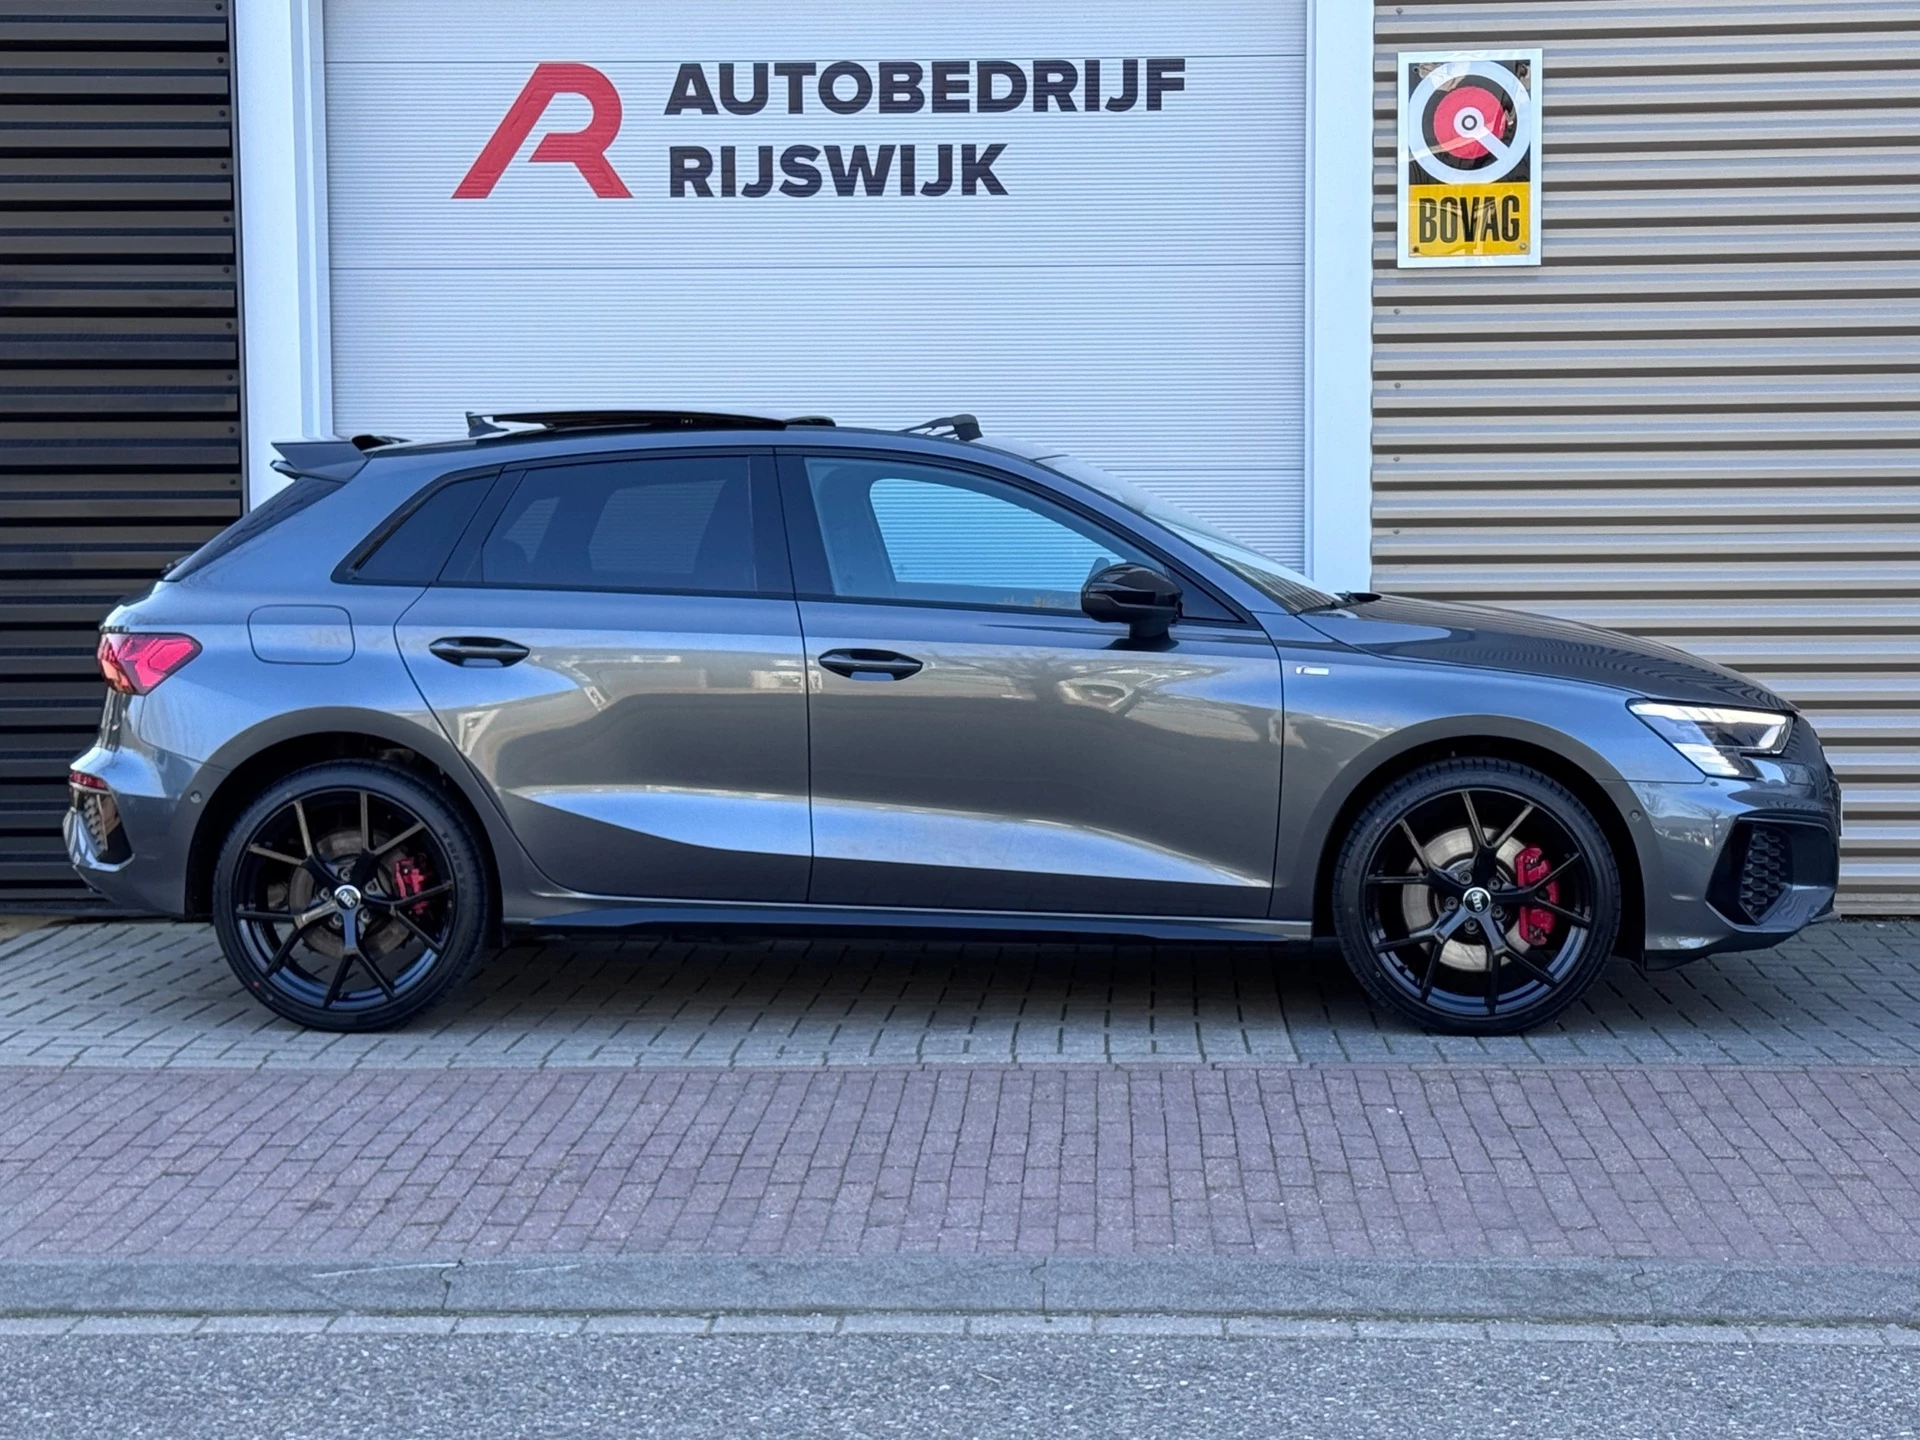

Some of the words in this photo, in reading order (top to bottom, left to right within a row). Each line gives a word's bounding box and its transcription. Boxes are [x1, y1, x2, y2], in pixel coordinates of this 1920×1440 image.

[664, 57, 1186, 116] AUTOBEDRIJF
[669, 143, 1009, 198] RIJSWIJK
[1418, 194, 1520, 244] BOVAG
